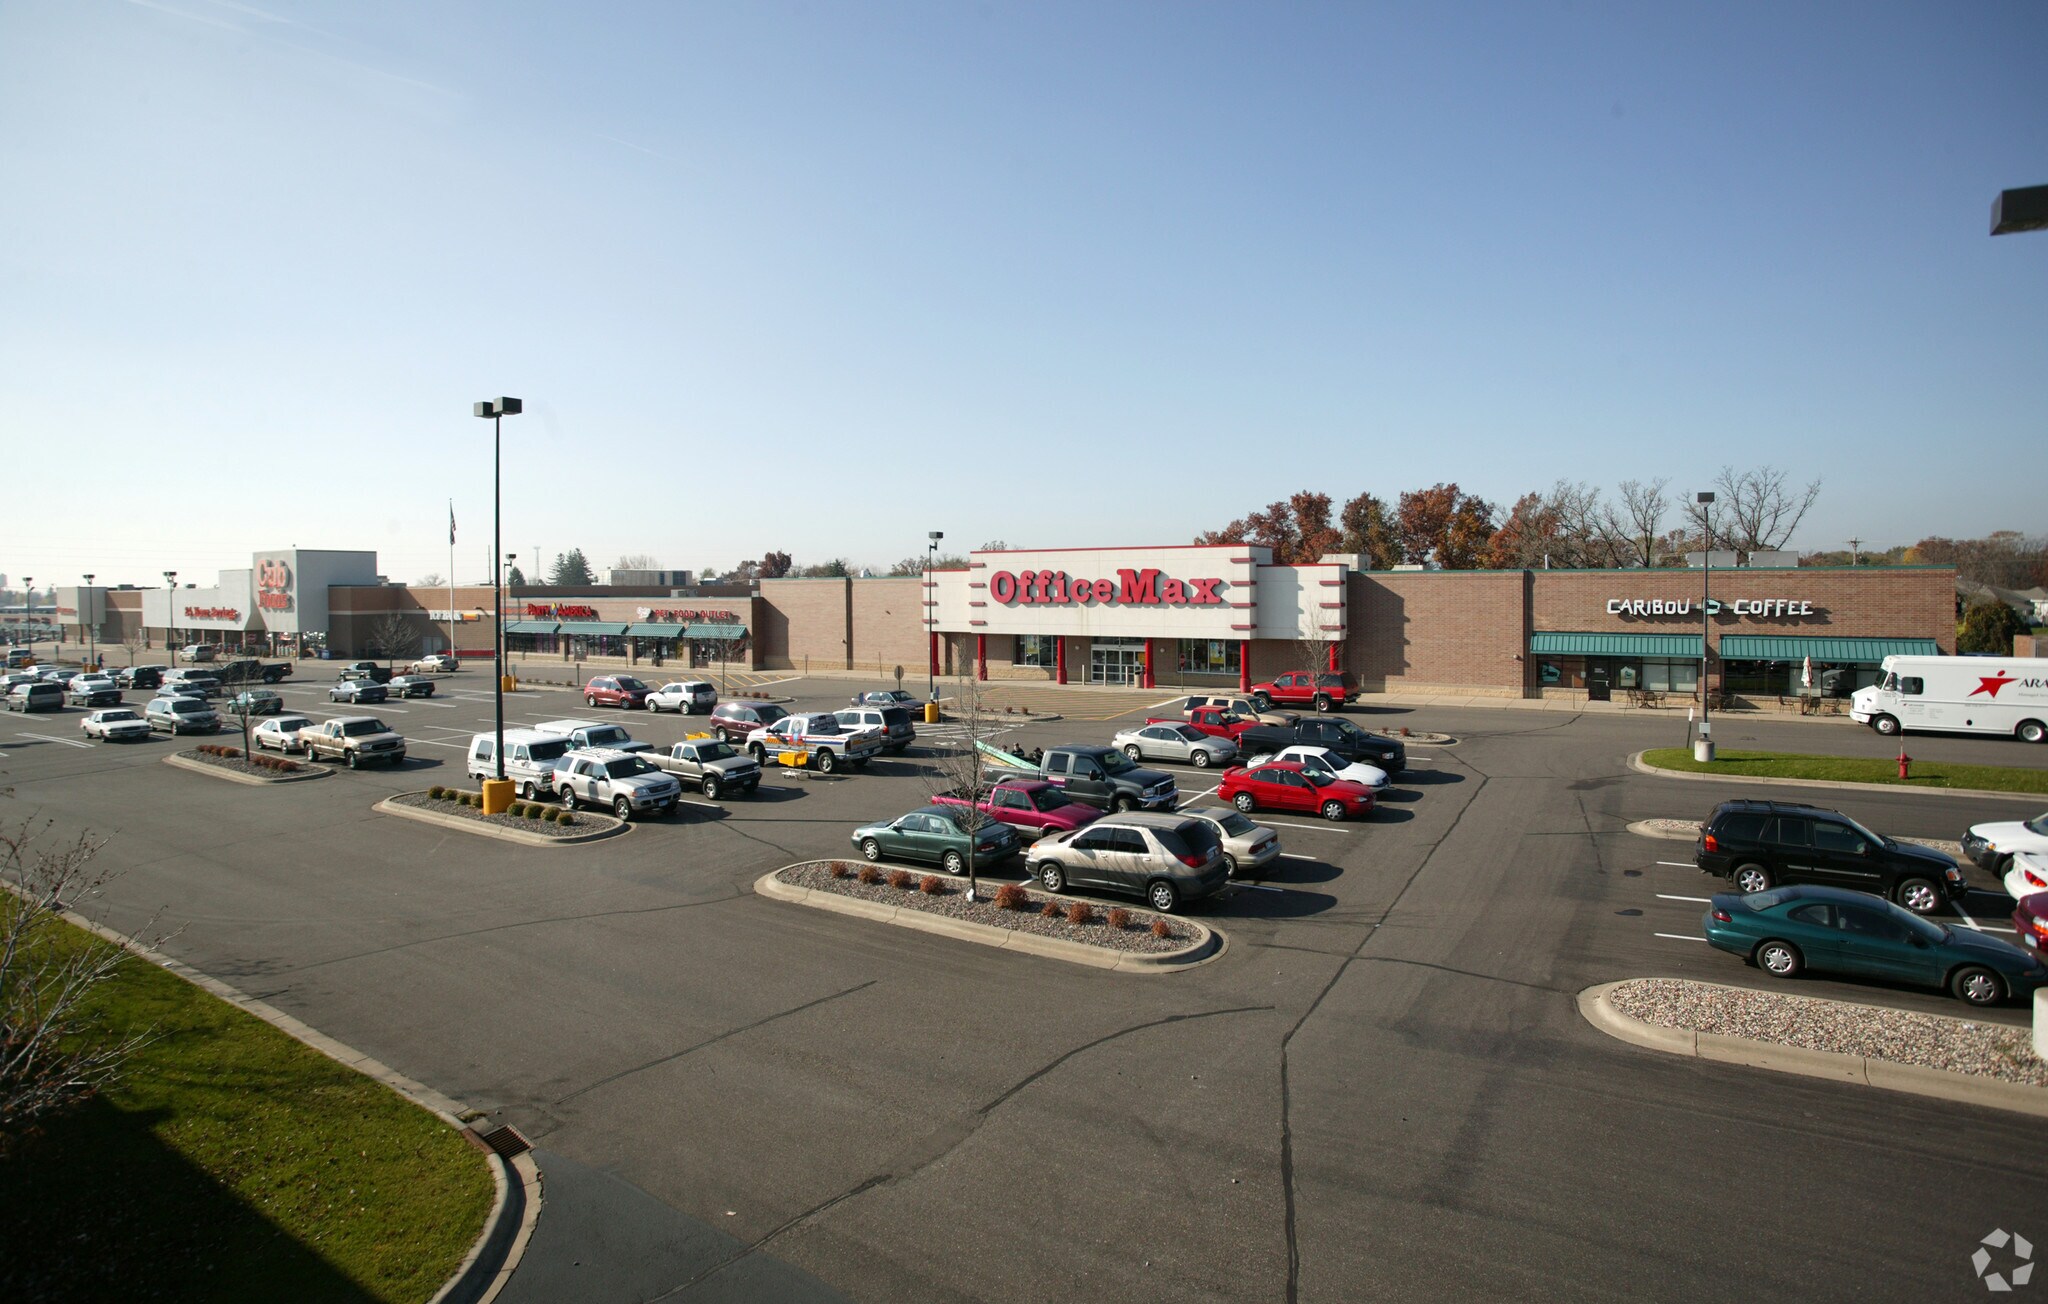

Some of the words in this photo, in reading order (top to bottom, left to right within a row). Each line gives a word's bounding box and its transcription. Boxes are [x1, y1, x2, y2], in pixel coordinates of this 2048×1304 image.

[257, 559, 287, 588] Cub
[990, 568, 1222, 604] OfficeMax
[655, 609, 668, 617] PET
[674, 609, 695, 618] FOOD
[700, 609, 730, 619] OUTLET
[1606, 598, 1690, 617] CARIBOU
[1733, 599, 1814, 617] COFFEE
